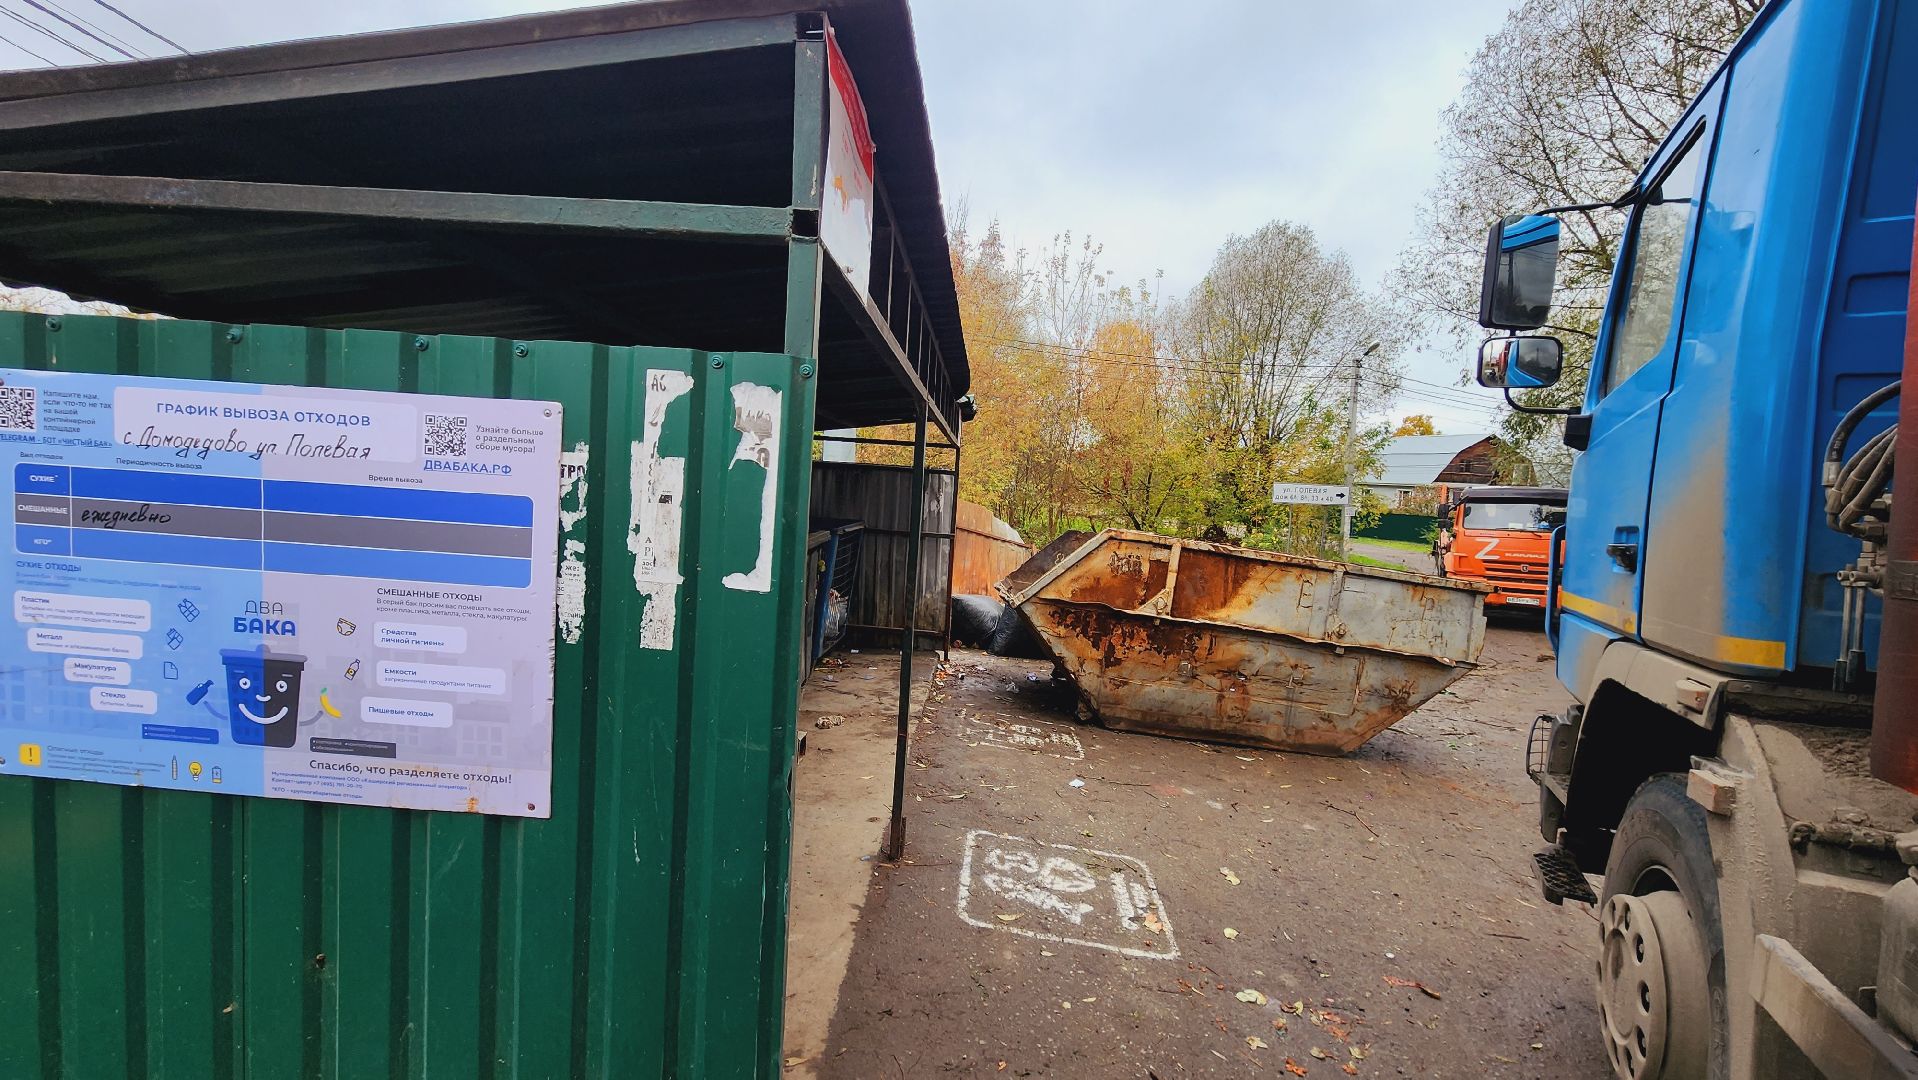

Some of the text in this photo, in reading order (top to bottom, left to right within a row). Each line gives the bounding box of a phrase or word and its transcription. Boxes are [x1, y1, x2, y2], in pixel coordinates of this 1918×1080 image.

[43, 390, 82, 398] Напишите
[156, 402, 371, 426] ГРАФИК ВЫВОЗА ОТХОДОВ
[476, 425, 544, 436] Узнайте больше
[43, 436, 56, 444] БОТ
[123, 425, 371, 460] с. Домодедово ул. Полевая
[483, 436, 534, 444] раздельном
[503, 445, 536, 454] мусора!
[116, 458, 174, 469] Периодичность
[424, 460, 512, 475] ДВАБАКА.РФ
[368, 474, 393, 482] Время
[17, 504, 68, 514] СМЕШАННЫЕ
[81, 504, 171, 529] ежедневно
[1475, 538, 1500, 560] Z
[16, 561, 81, 572] СУХИЕ ОТХОДЫ
[377, 587, 482, 602] СМЕШАННЫЕ ОТХОДЫ
[245, 600, 284, 615] ДВА
[418, 602, 444, 610] просим
[458, 604, 491, 612] помещать
[234, 617, 296, 636] БАКА
[381, 628, 417, 636] Средства
[411, 639, 445, 647] гигиены
[73, 663, 116, 672] Макулатура
[384, 668, 417, 676] Емкости
[100, 691, 126, 699] Стекло
[369, 706, 434, 718] Пищевые отходы
[310, 760, 512, 784] Спасибо, что разделяете отходы!
